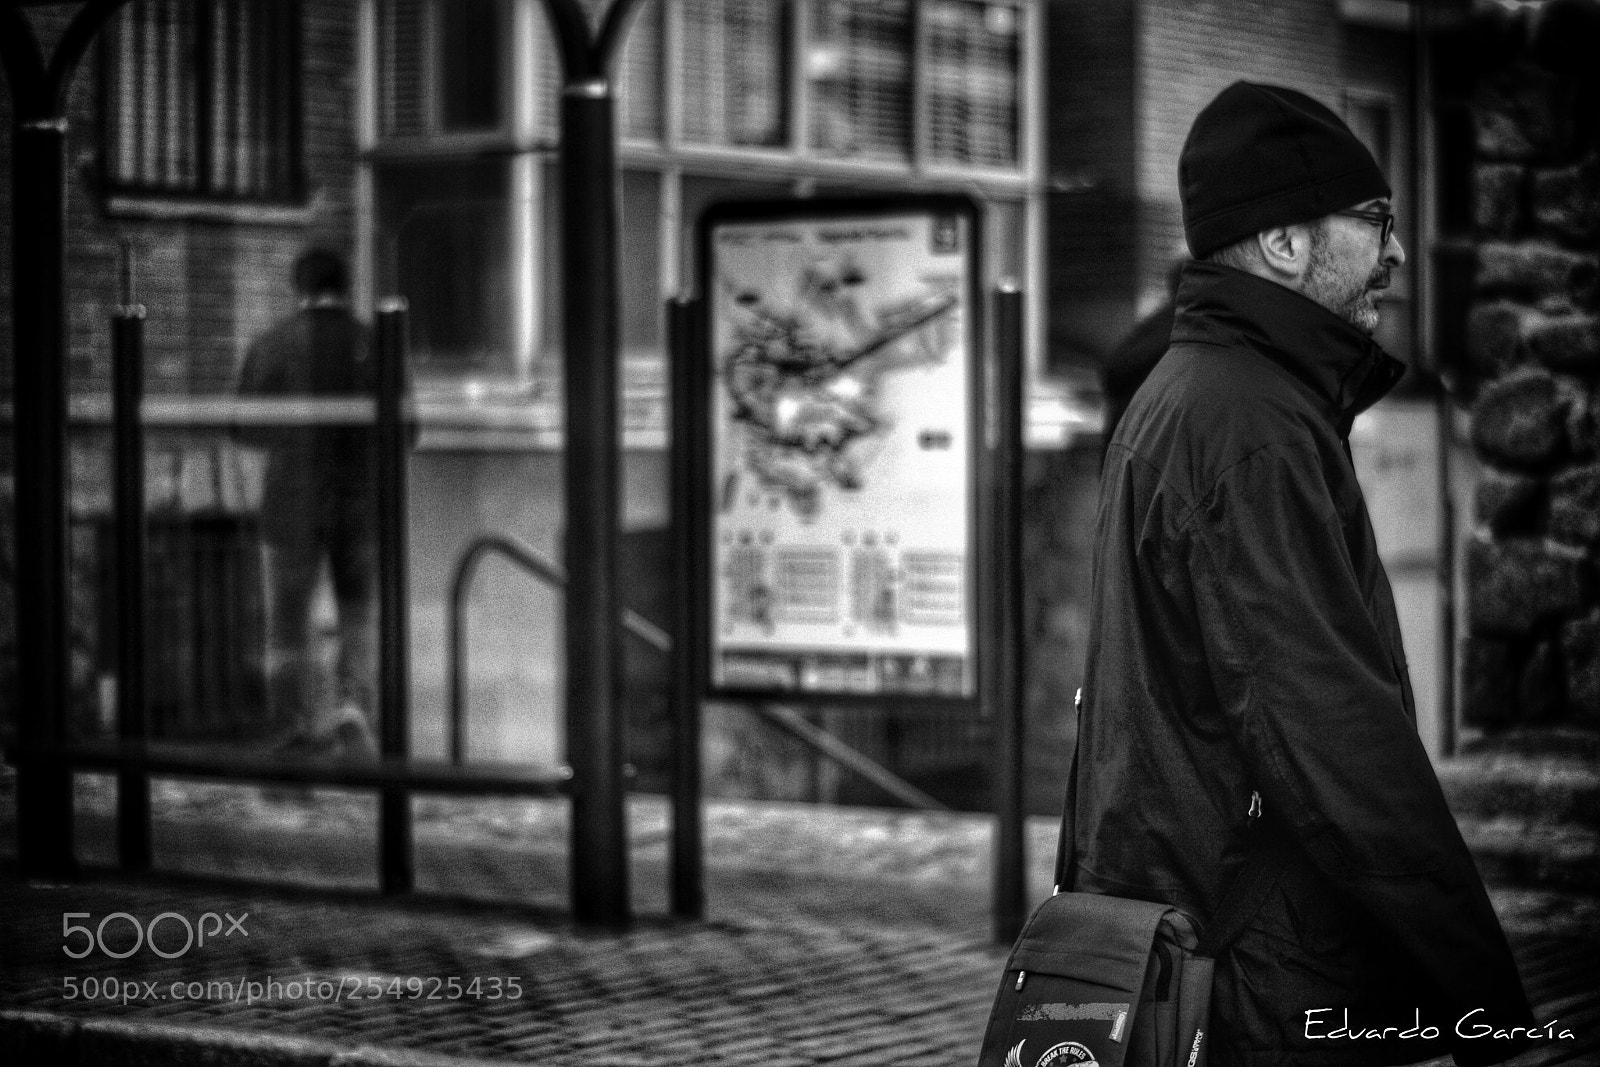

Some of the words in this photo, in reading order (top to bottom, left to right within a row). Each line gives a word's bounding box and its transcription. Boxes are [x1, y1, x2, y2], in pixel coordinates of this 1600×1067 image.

[1040, 1049, 1059, 1067] BREAK
[1059, 1046, 1070, 1056] THE
[1070, 1046, 1087, 1060] RULES
